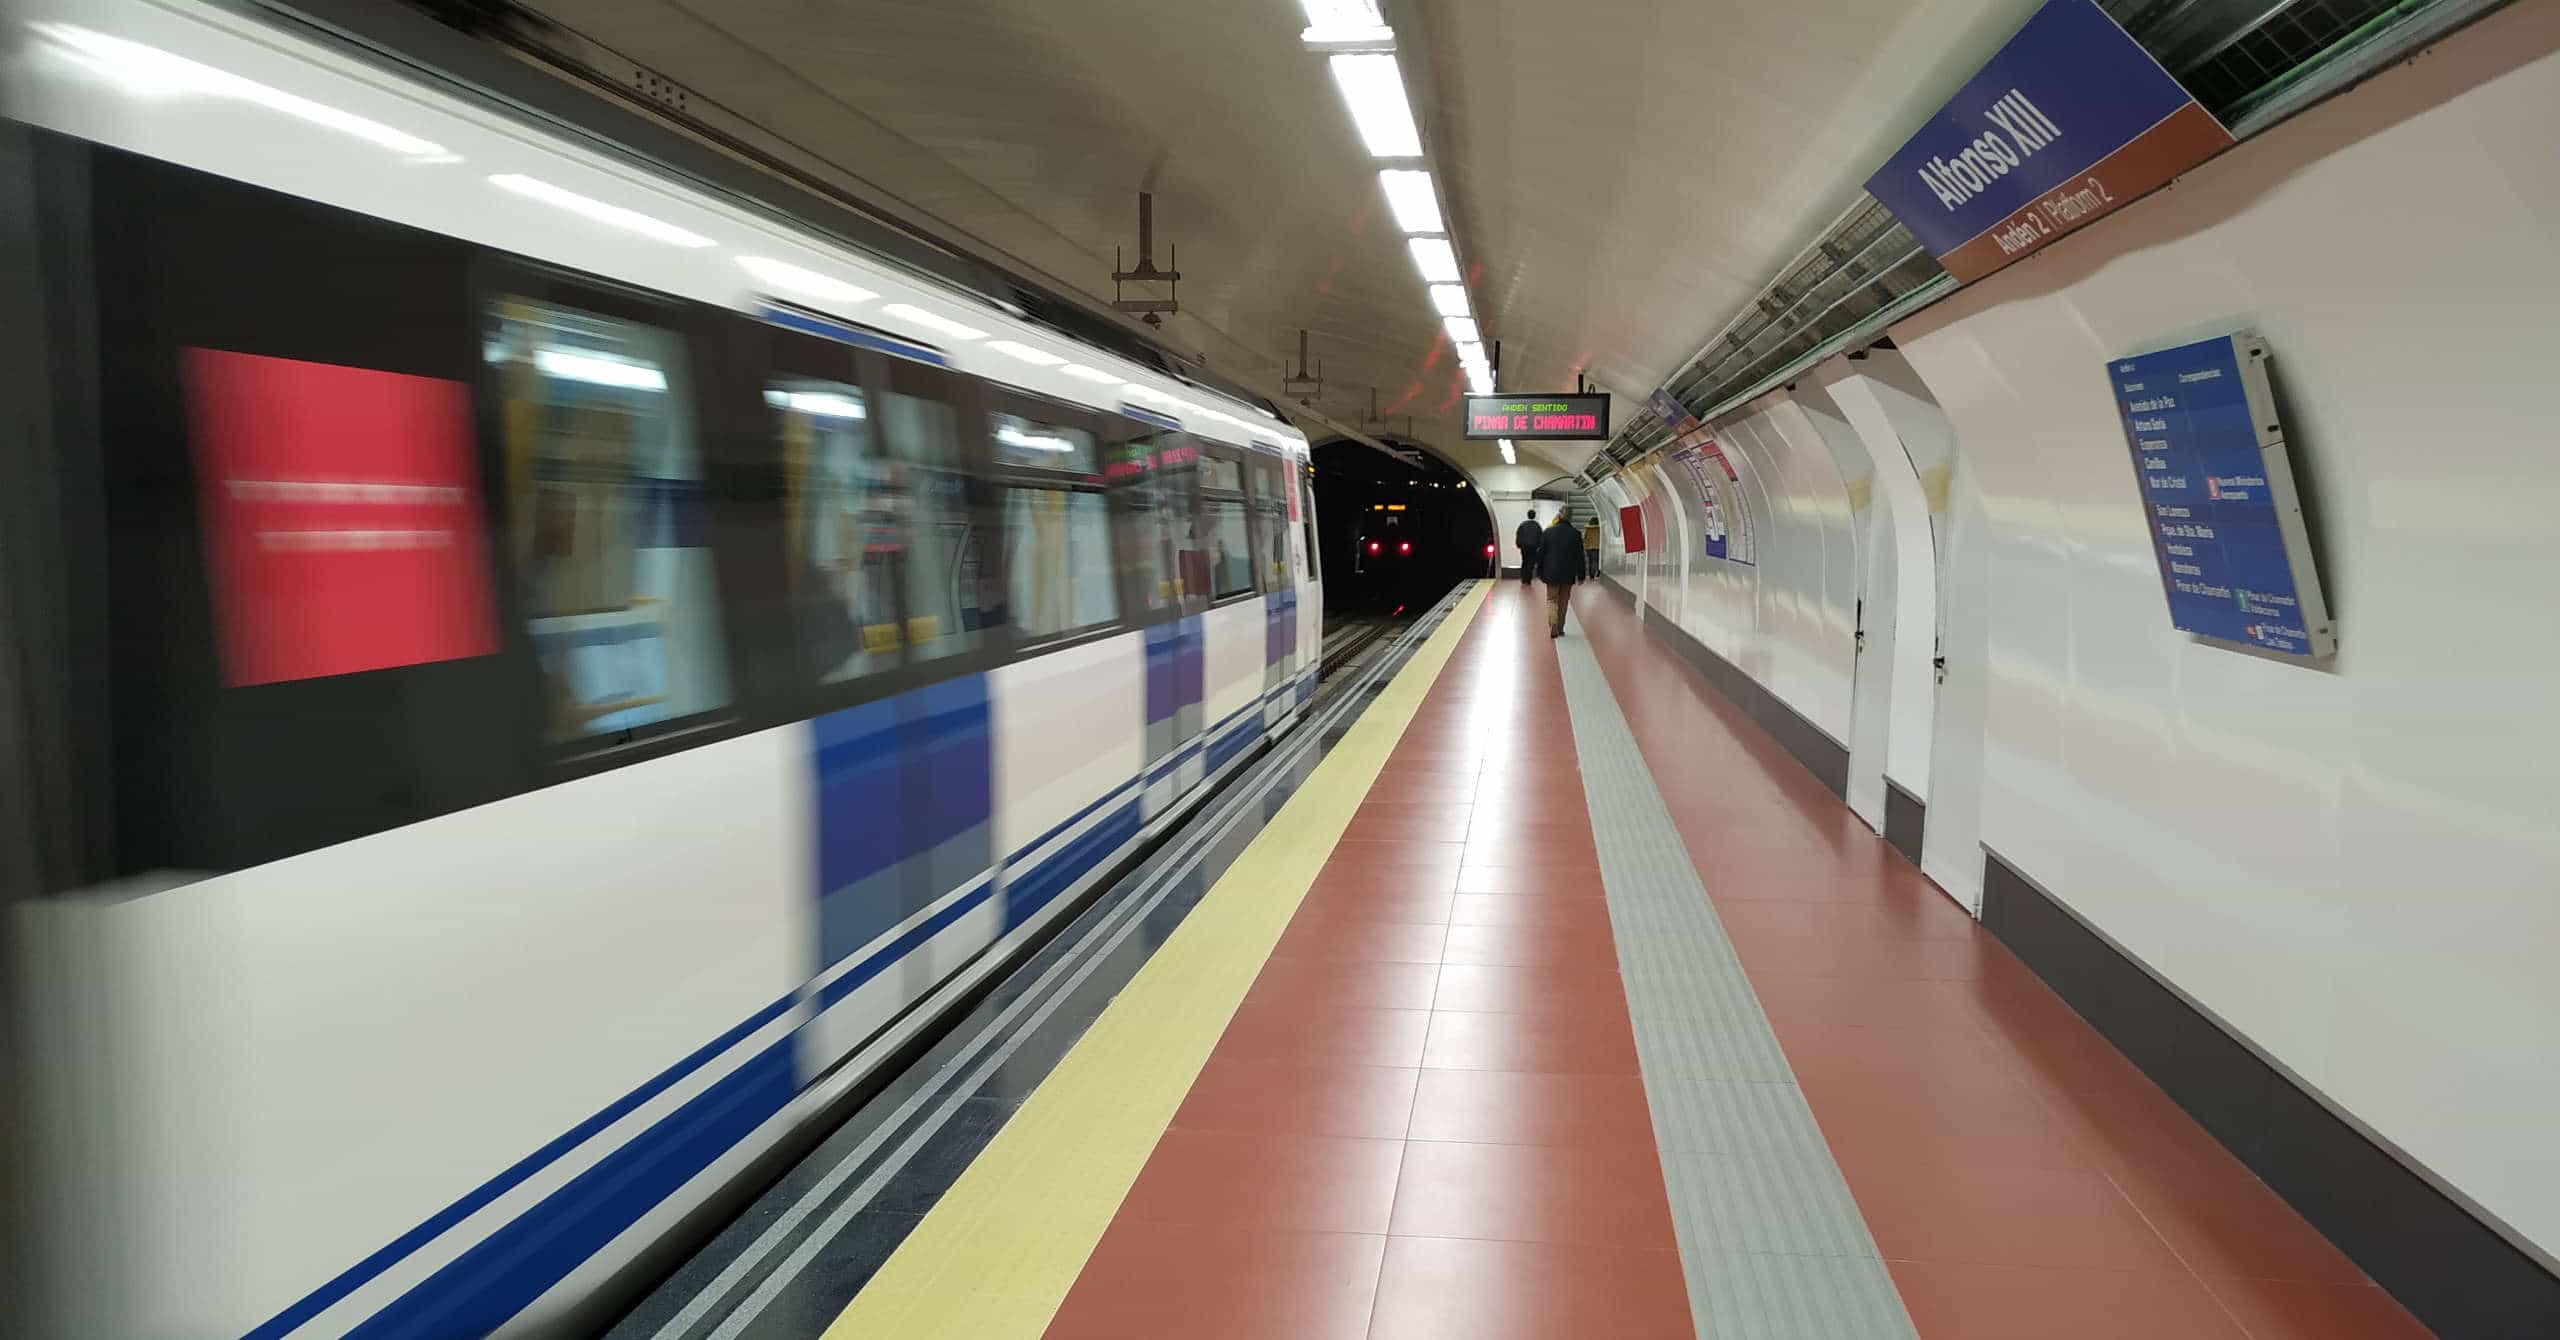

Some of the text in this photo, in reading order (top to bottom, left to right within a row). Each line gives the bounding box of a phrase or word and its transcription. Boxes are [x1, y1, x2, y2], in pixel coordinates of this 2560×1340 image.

[1917, 88, 2062, 211] Alfonso XIII
[1991, 177, 2114, 255] Andén 2 Platform 2
[1474, 414, 1509, 430] PINAR
[1513, 414, 1528, 430] DE
[1532, 403, 1569, 412] SENTIDO
